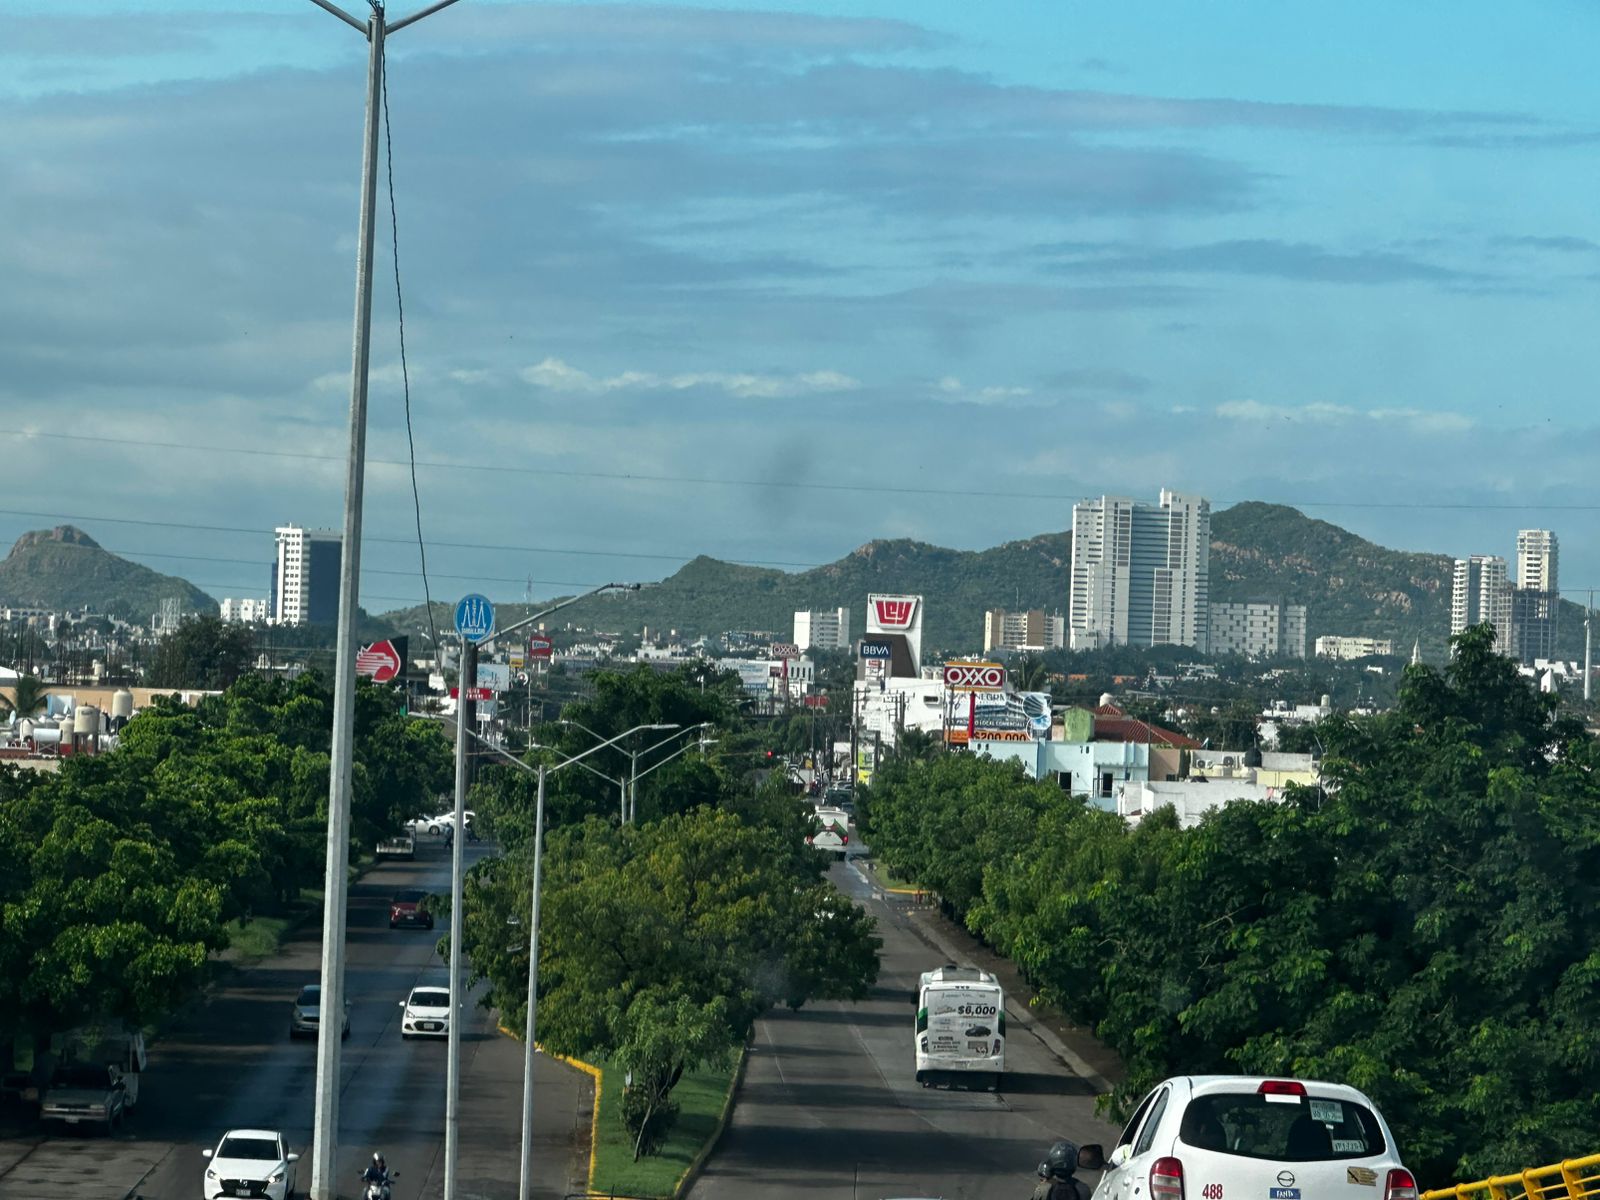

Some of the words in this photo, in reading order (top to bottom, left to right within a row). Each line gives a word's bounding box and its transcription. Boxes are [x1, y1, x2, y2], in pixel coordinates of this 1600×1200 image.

[773, 646, 798, 656] OXXO
[863, 645, 889, 655] BBVA
[946, 667, 1001, 686] OXXO
[957, 1005, 996, 1015] $6,000
[1202, 1184, 1223, 1199] 488
